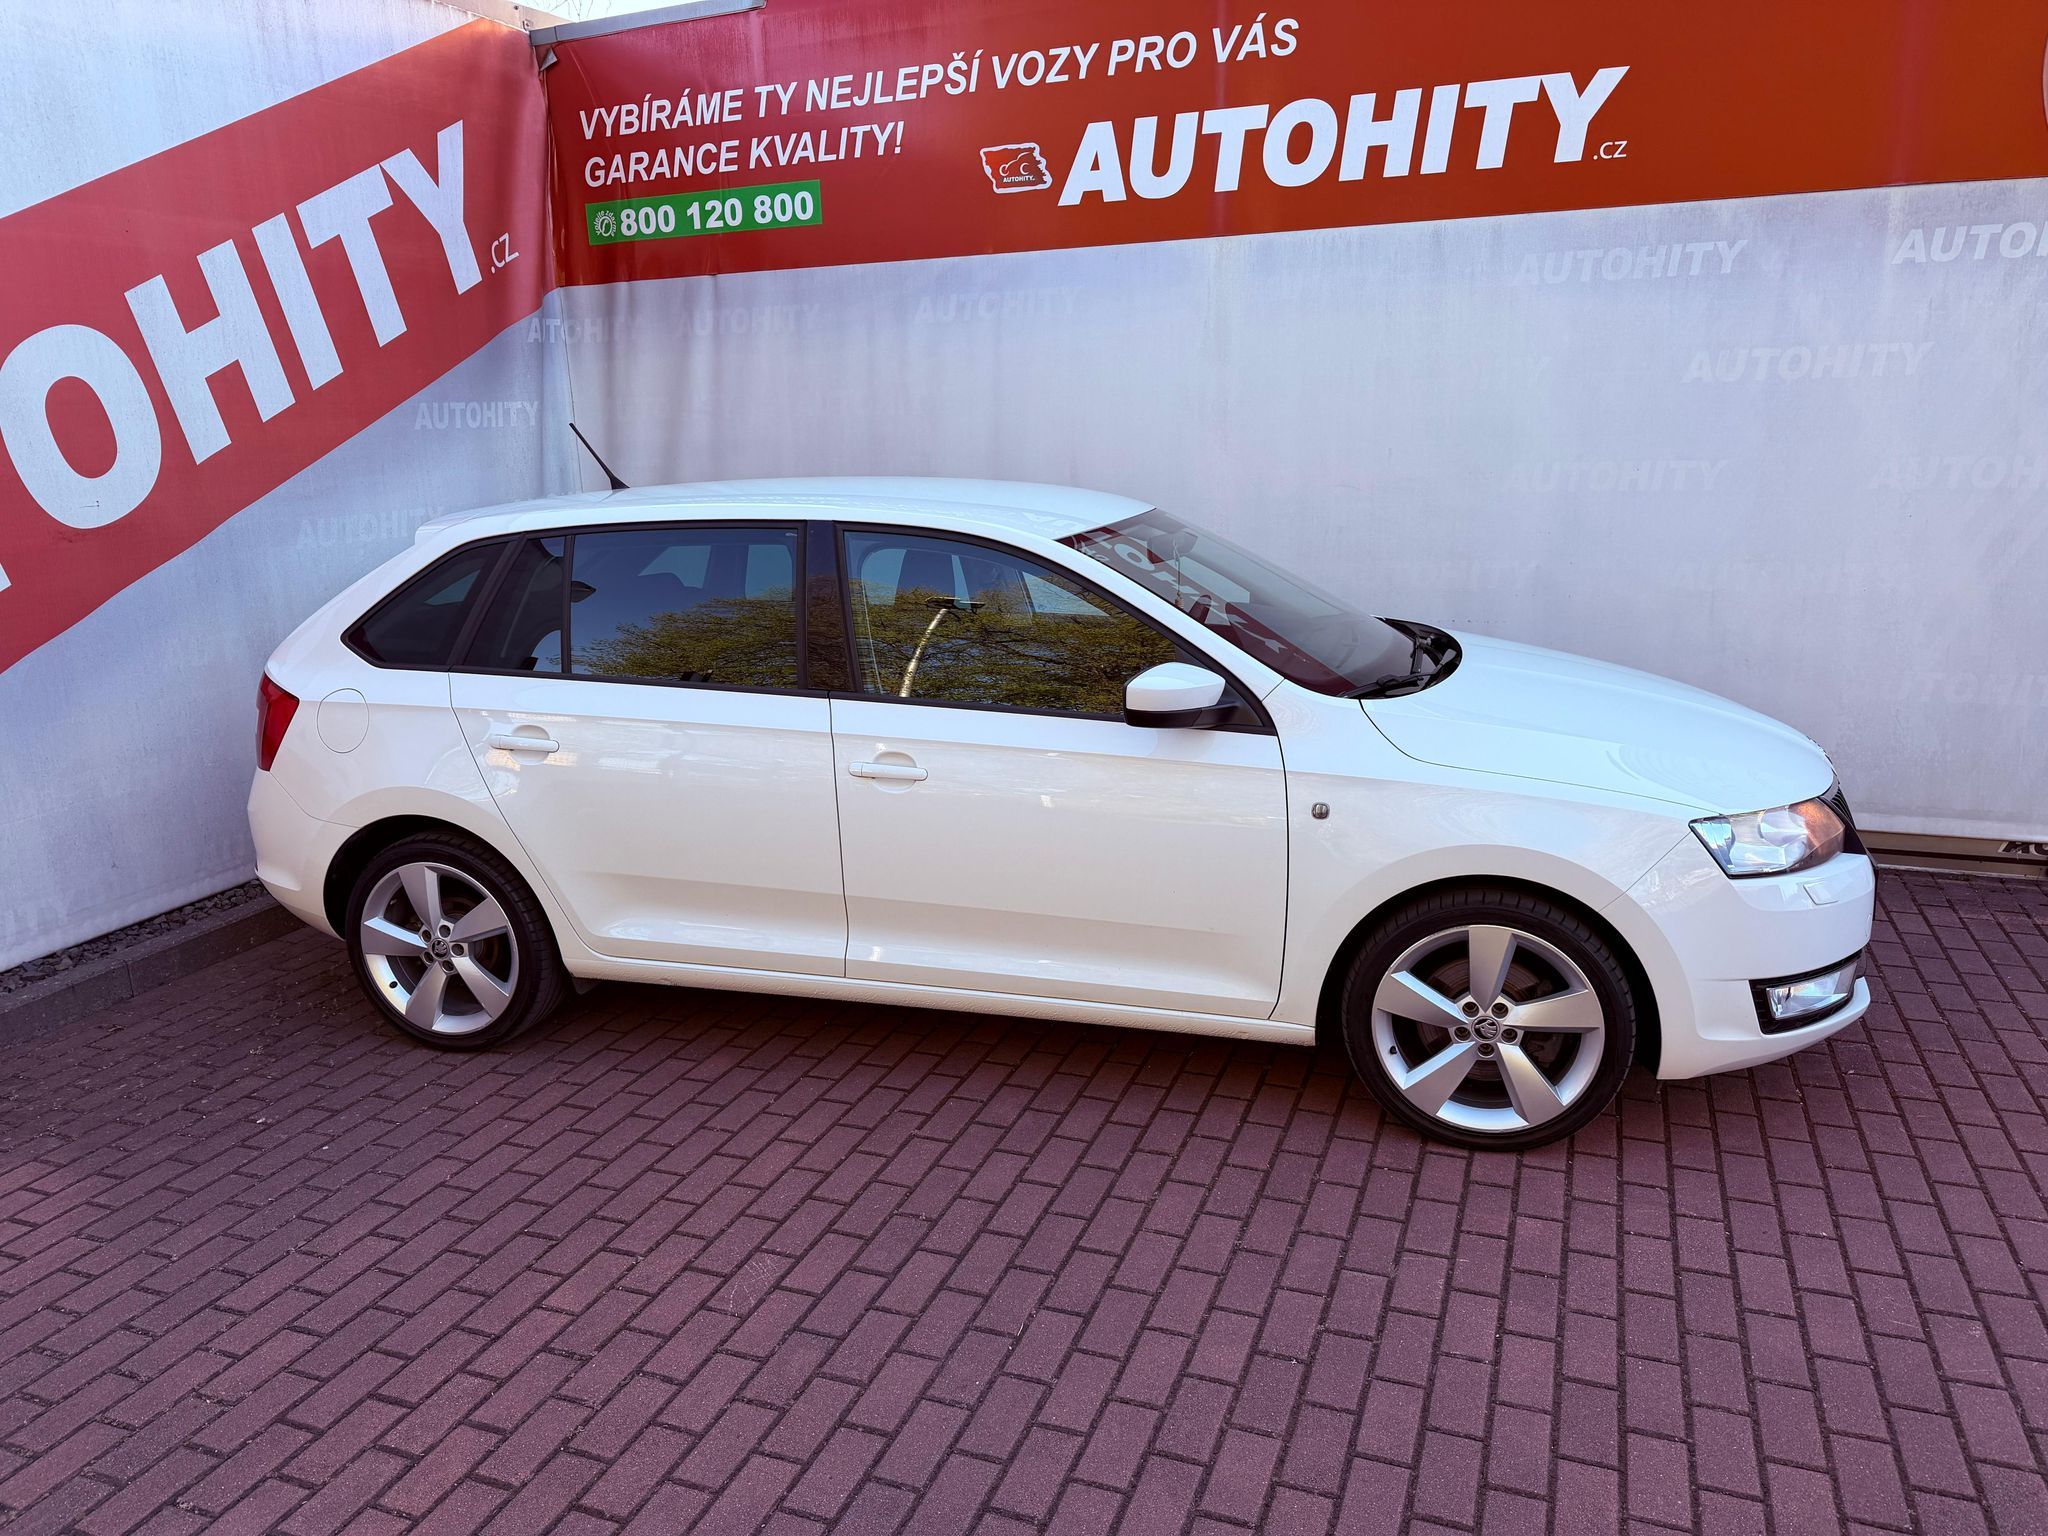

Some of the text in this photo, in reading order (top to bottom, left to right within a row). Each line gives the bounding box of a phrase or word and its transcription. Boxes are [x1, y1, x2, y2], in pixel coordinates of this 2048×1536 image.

[579, 12, 1300, 140] VYBÍRÁME TY NEJLEPŠÍ VOZY PRO VÁS
[584, 120, 905, 188] GARANCE KVALITY!
[620, 190, 815, 237] 800 120 800
[1512, 238, 1749, 286] AUTOHITY
[914, 286, 1084, 324] AUTOHITY
[1681, 341, 1935, 384] AUTOHITY
[414, 400, 539, 430] AUTOHITY
[1500, 459, 1730, 493] AUTOHITY
